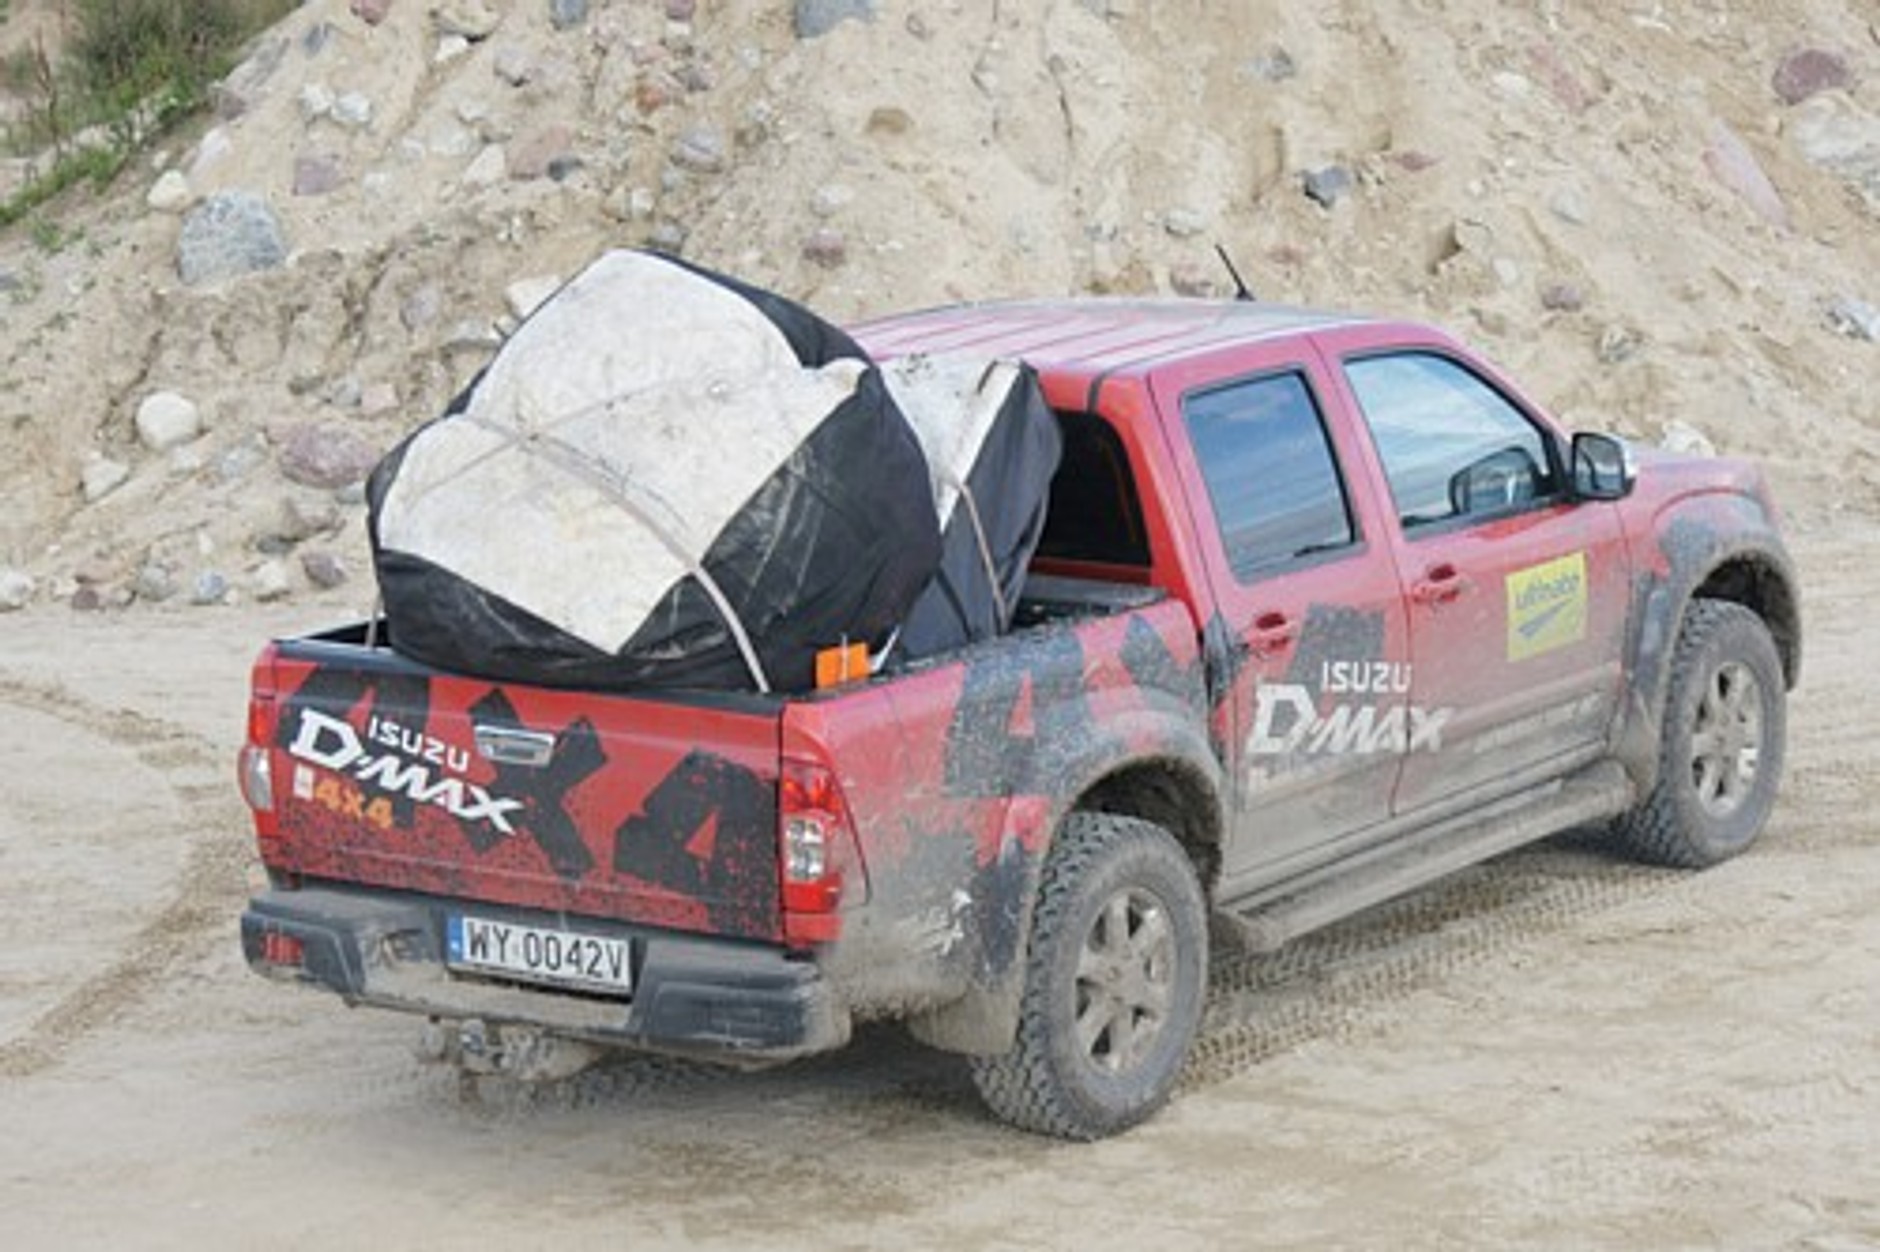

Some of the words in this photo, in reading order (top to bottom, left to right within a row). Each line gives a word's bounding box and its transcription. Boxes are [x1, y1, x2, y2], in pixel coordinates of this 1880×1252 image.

[1322, 659, 1413, 695] ISUZU
[368, 714, 471, 773] ISUZU
[467, 921, 512, 964] WY
[523, 931, 625, 981] 0042V
